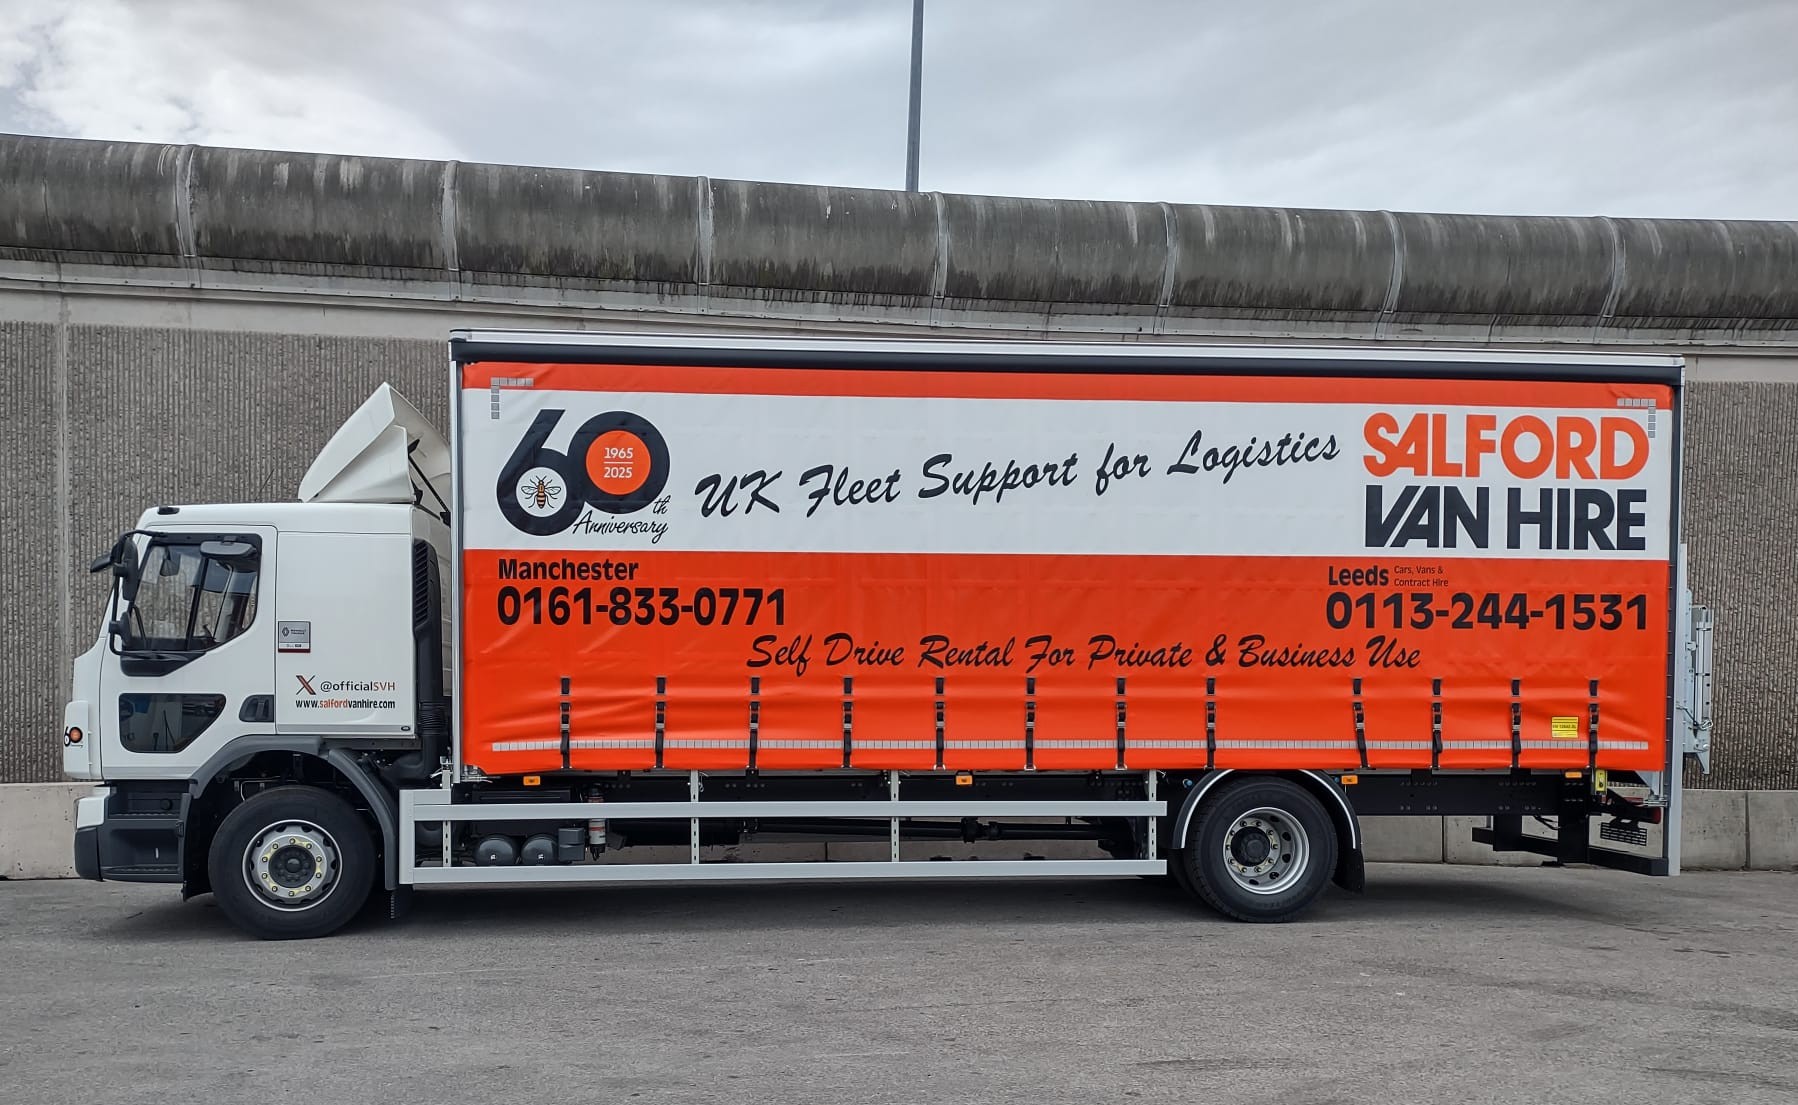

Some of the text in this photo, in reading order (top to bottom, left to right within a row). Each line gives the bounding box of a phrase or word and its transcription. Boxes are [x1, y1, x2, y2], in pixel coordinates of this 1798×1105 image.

[603, 447, 634, 459] 1965
[1363, 412, 1650, 480] SALFORD
[496, 409, 671, 536] 60 th
[603, 466, 633, 478] 2025
[695, 429, 1340, 518] UK Fleet Support for Logistics
[572, 509, 669, 544] Anniversary
[1365, 485, 1647, 551] VAN HIRE
[498, 558, 639, 580] Manchester
[1328, 565, 1389, 586] Leeds
[1394, 565, 1444, 575] Cars, Vans &
[1394, 578, 1449, 587] Contract Hire
[497, 585, 785, 626] 0161-833-0771
[1326, 591, 1647, 630] 0113-244-1531
[746, 633, 1421, 677] Self Drive Rental For Private & Business Use
[320, 680, 395, 692] @officialSVH
[295, 699, 396, 709] www.salfordvanhire.com
